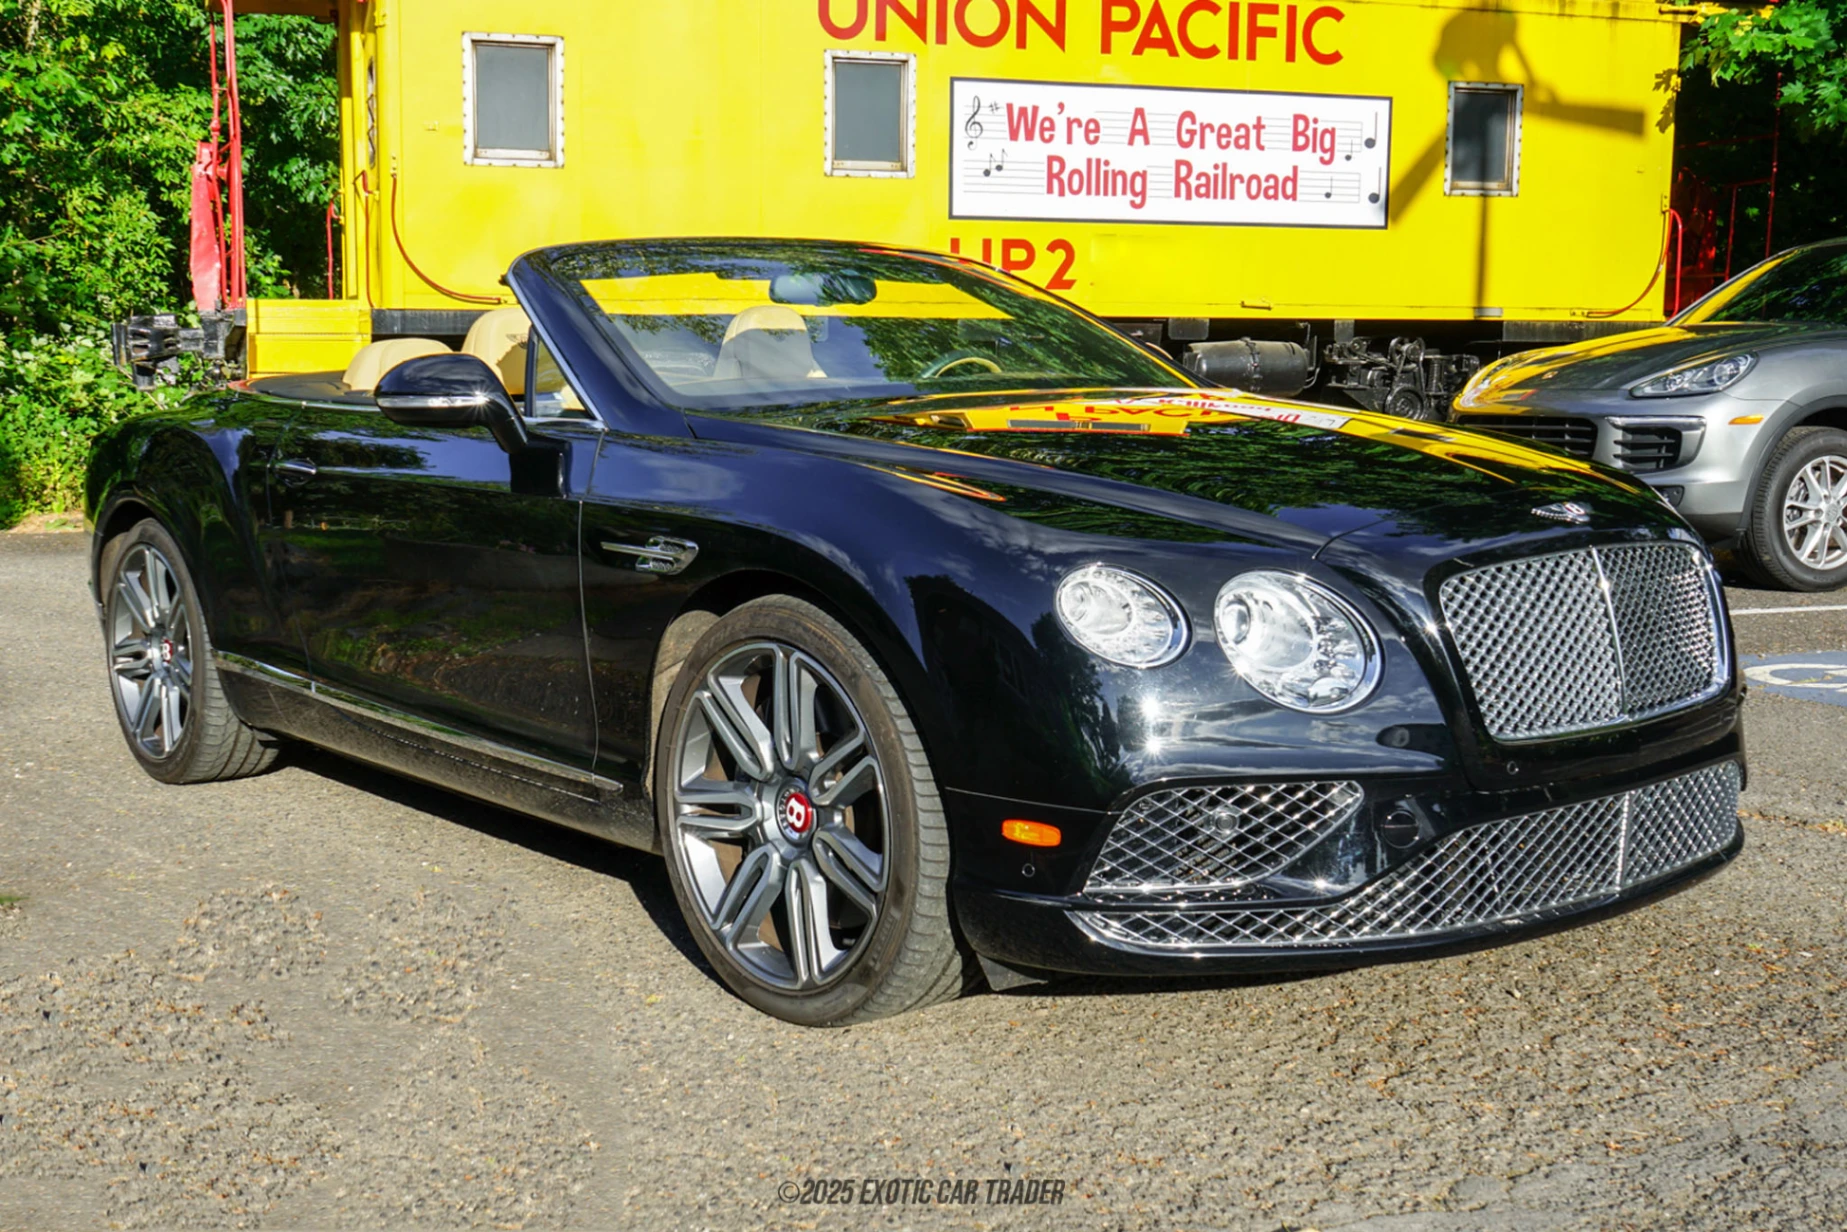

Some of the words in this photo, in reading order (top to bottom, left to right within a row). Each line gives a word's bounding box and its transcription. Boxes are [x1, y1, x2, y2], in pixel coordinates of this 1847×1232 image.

[818, 0, 1067, 52] UNION
[1100, 0, 1345, 66] PACIFIC
[1006, 102, 1101, 147] We're
[1128, 107, 1150, 146] A
[1176, 110, 1266, 152] Great
[1292, 114, 1337, 166] Big
[1047, 155, 1148, 209] Rolling
[1174, 159, 1299, 201] Railroad
[786, 797, 806, 829] B
